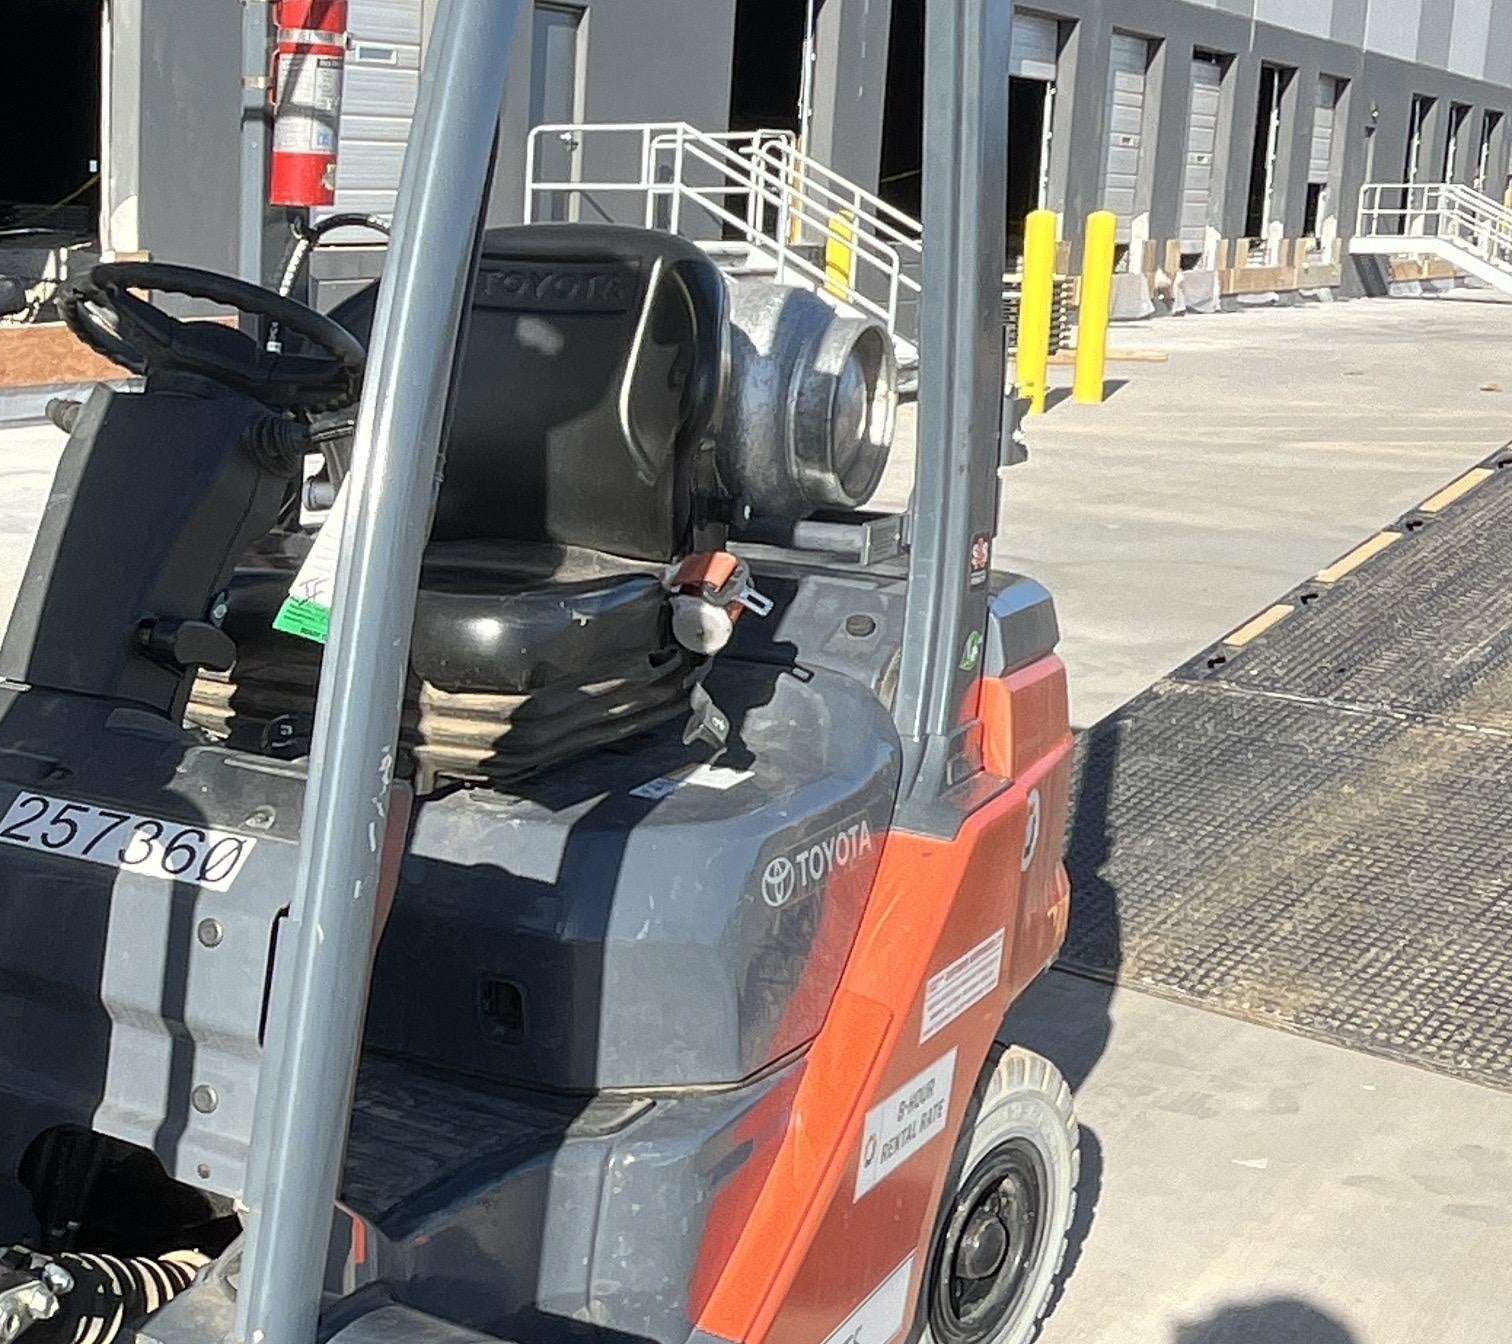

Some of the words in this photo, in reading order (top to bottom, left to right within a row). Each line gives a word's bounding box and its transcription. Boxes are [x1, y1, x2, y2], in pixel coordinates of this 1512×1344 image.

[0, 796, 247, 883] 257360
[795, 820, 872, 886] TOYOTA
[880, 1120, 917, 1165] RENTAL
[918, 1099, 945, 1134] RATE
[896, 1077, 936, 1122] 8-HOUR
